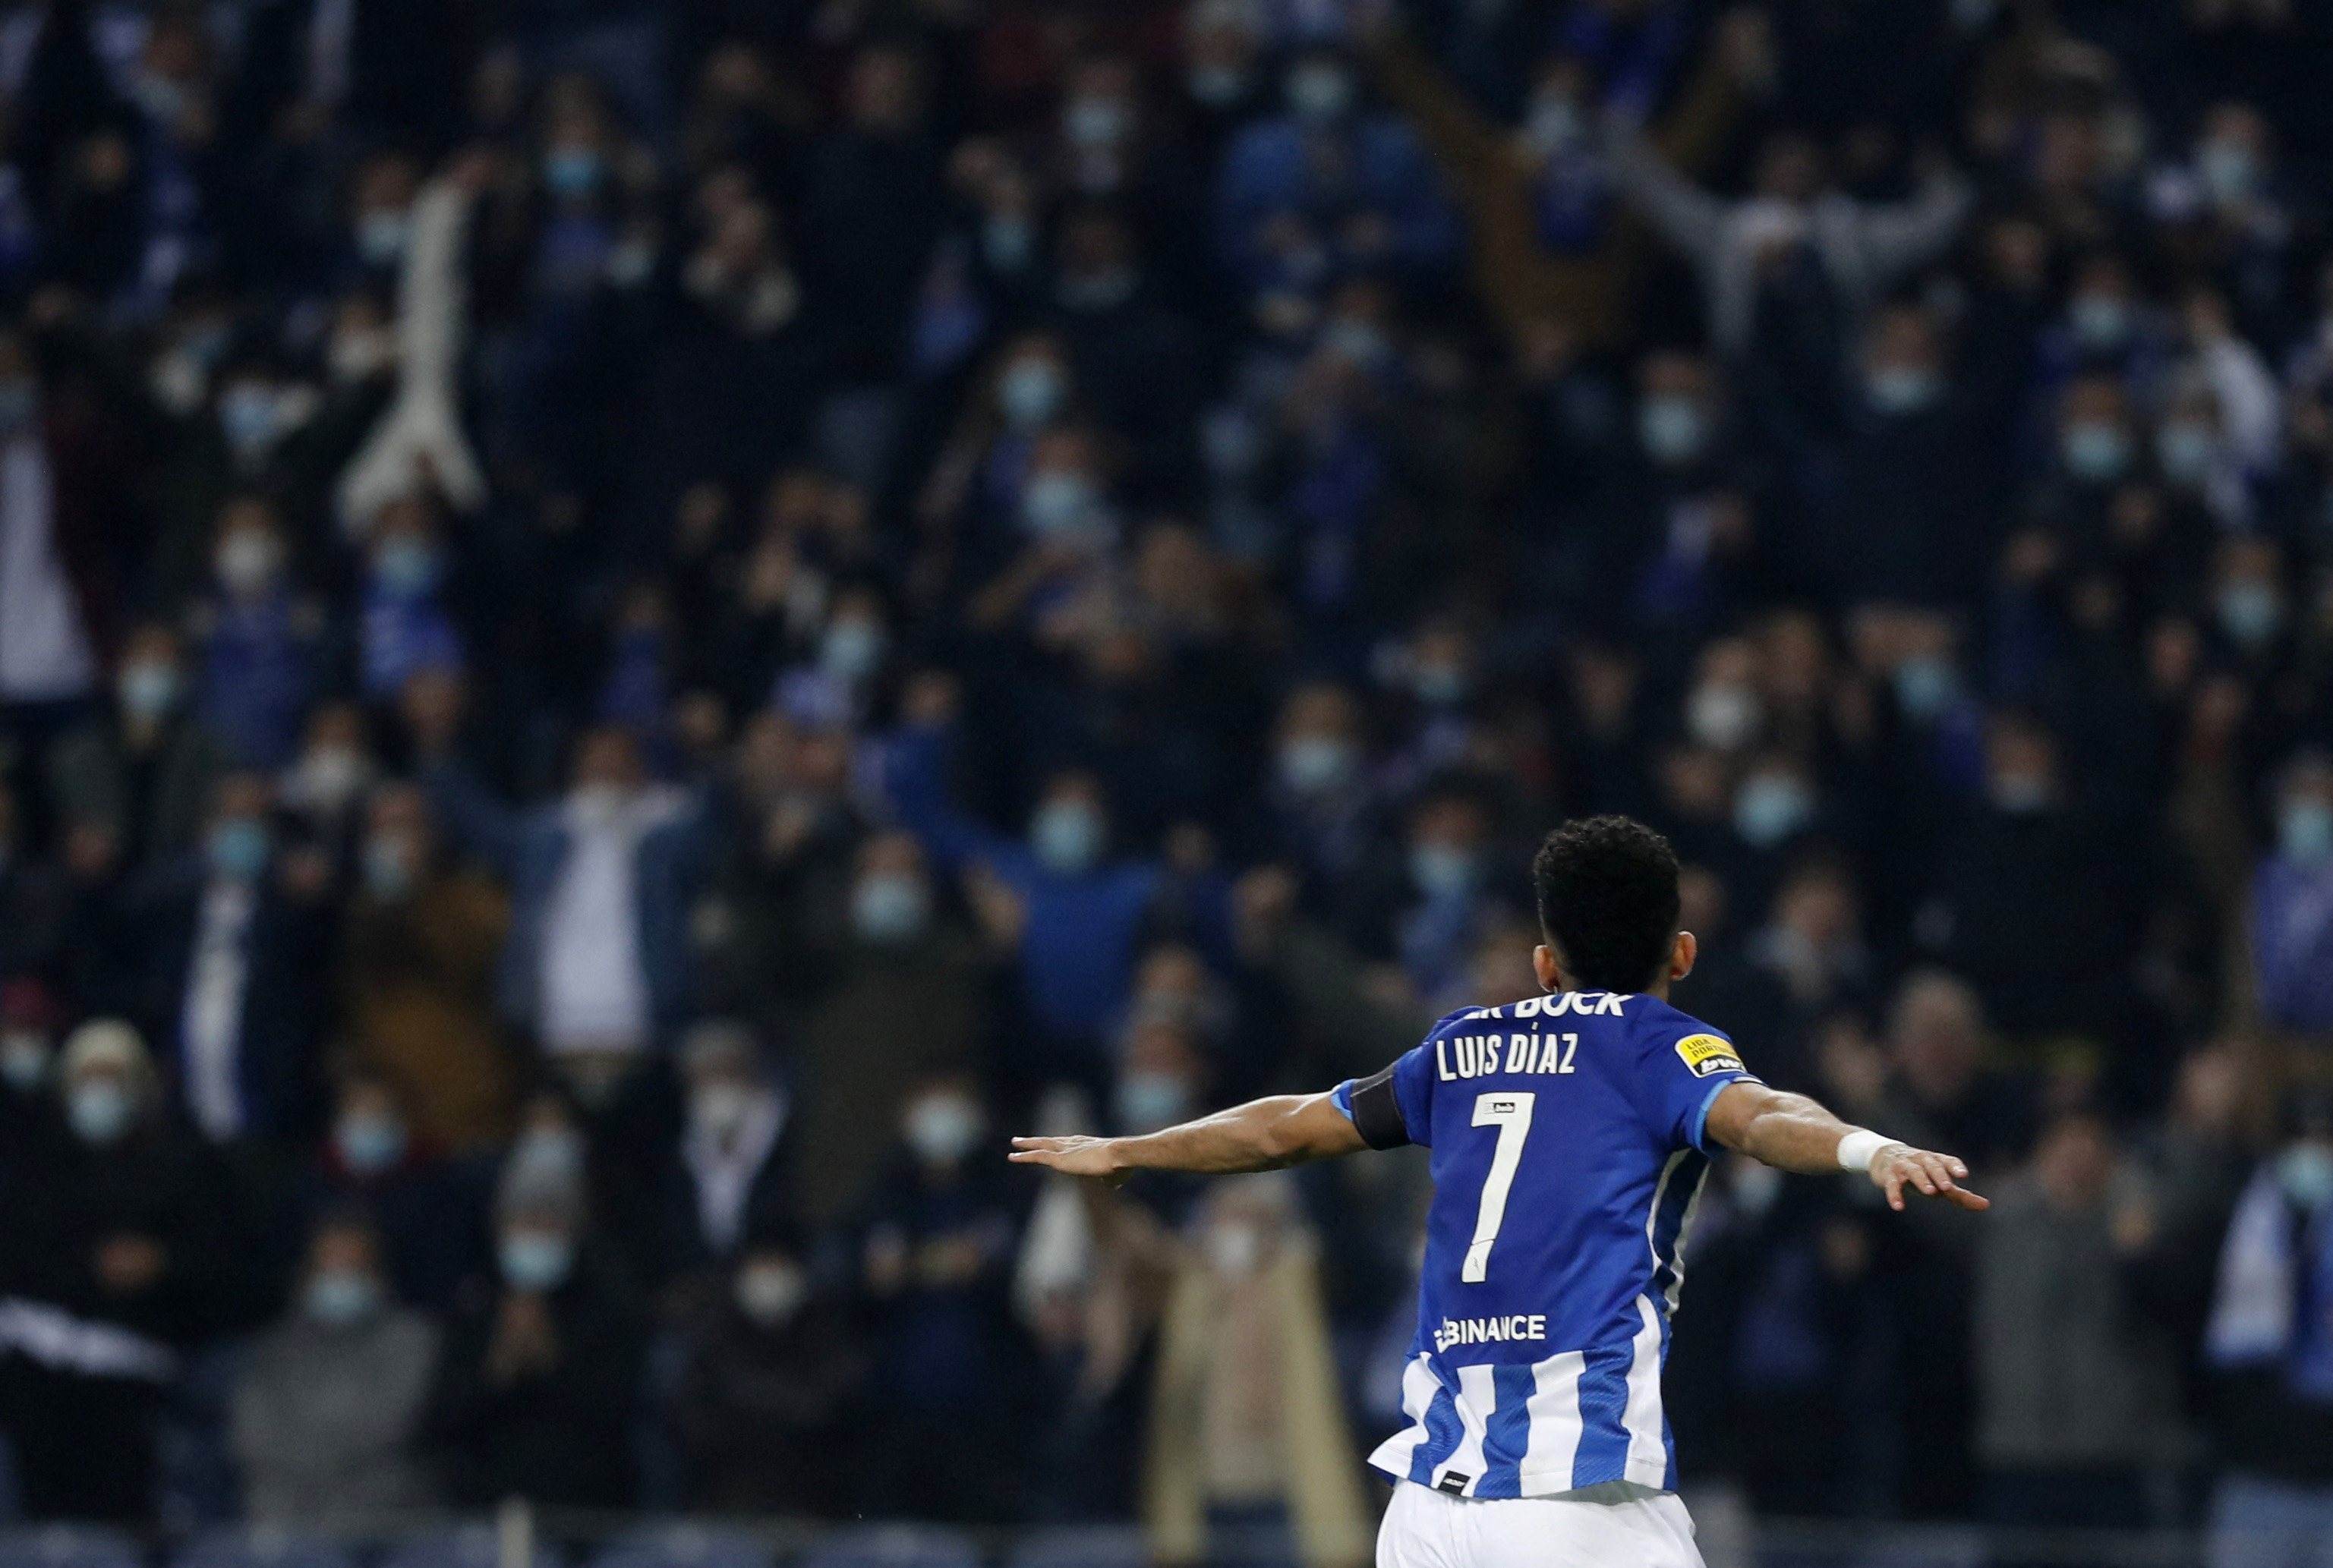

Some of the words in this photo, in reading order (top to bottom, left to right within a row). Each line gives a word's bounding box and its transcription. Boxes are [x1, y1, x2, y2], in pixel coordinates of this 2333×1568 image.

[1515, 991, 1635, 1018] BOCK
[1436, 1035, 1502, 1082] LUIS
[1504, 1022, 1578, 1074] DÍAZ
[1461, 1091, 1536, 1283] 7
[1443, 1315, 1546, 1346] BINANCE
